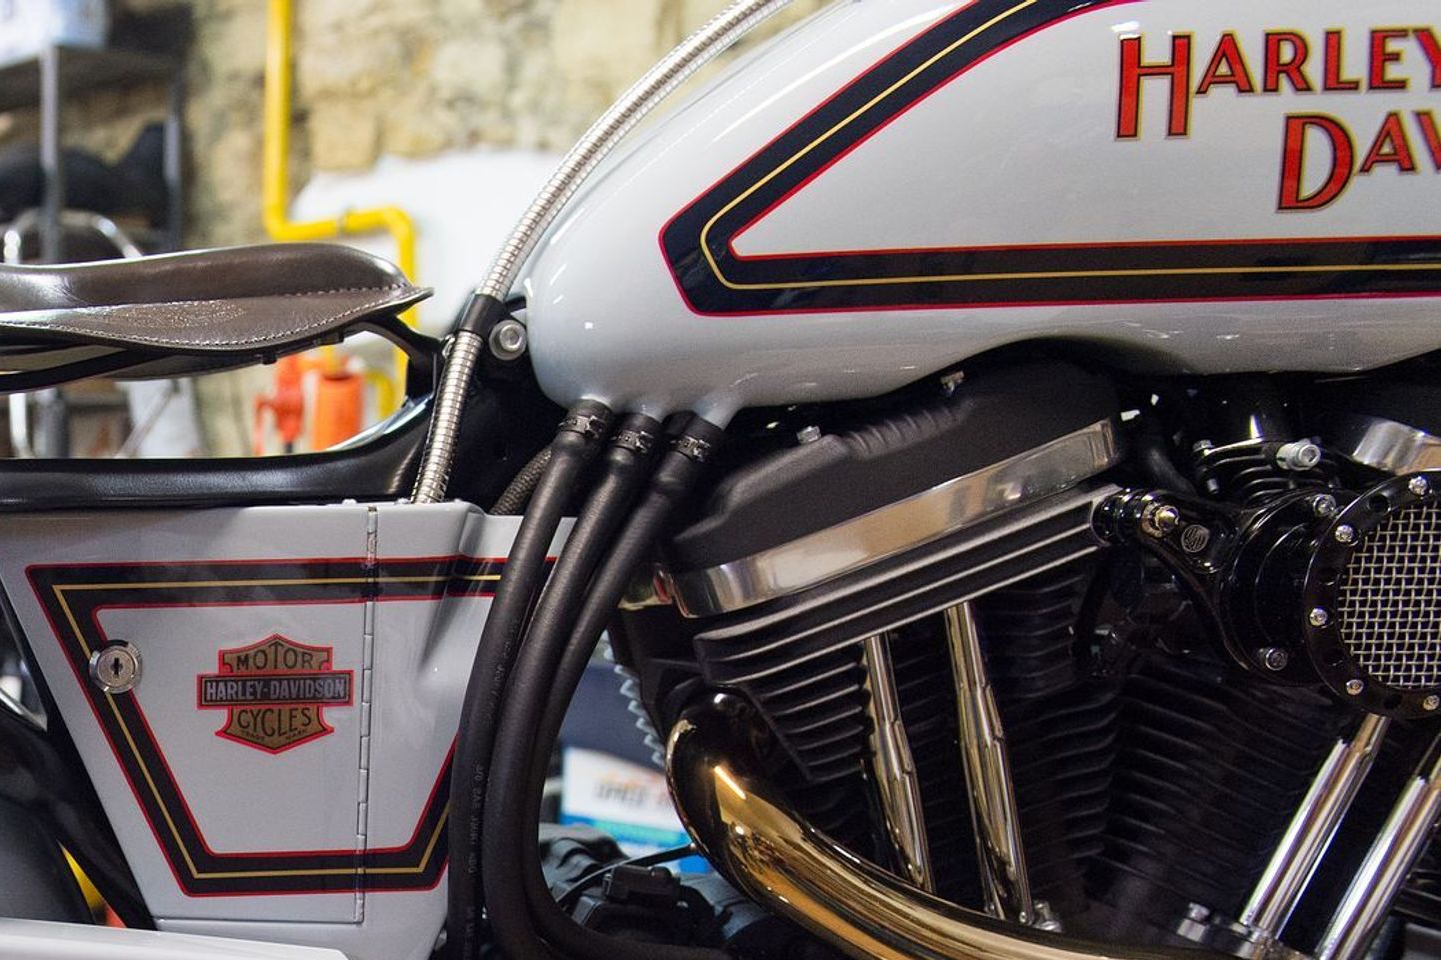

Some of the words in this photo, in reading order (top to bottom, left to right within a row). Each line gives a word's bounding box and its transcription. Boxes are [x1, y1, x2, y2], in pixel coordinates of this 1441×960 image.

[236, 640, 314, 671] MOTOR
[206, 678, 345, 701] HARLEY-DAVIDSON
[237, 707, 312, 737] CYCLES
